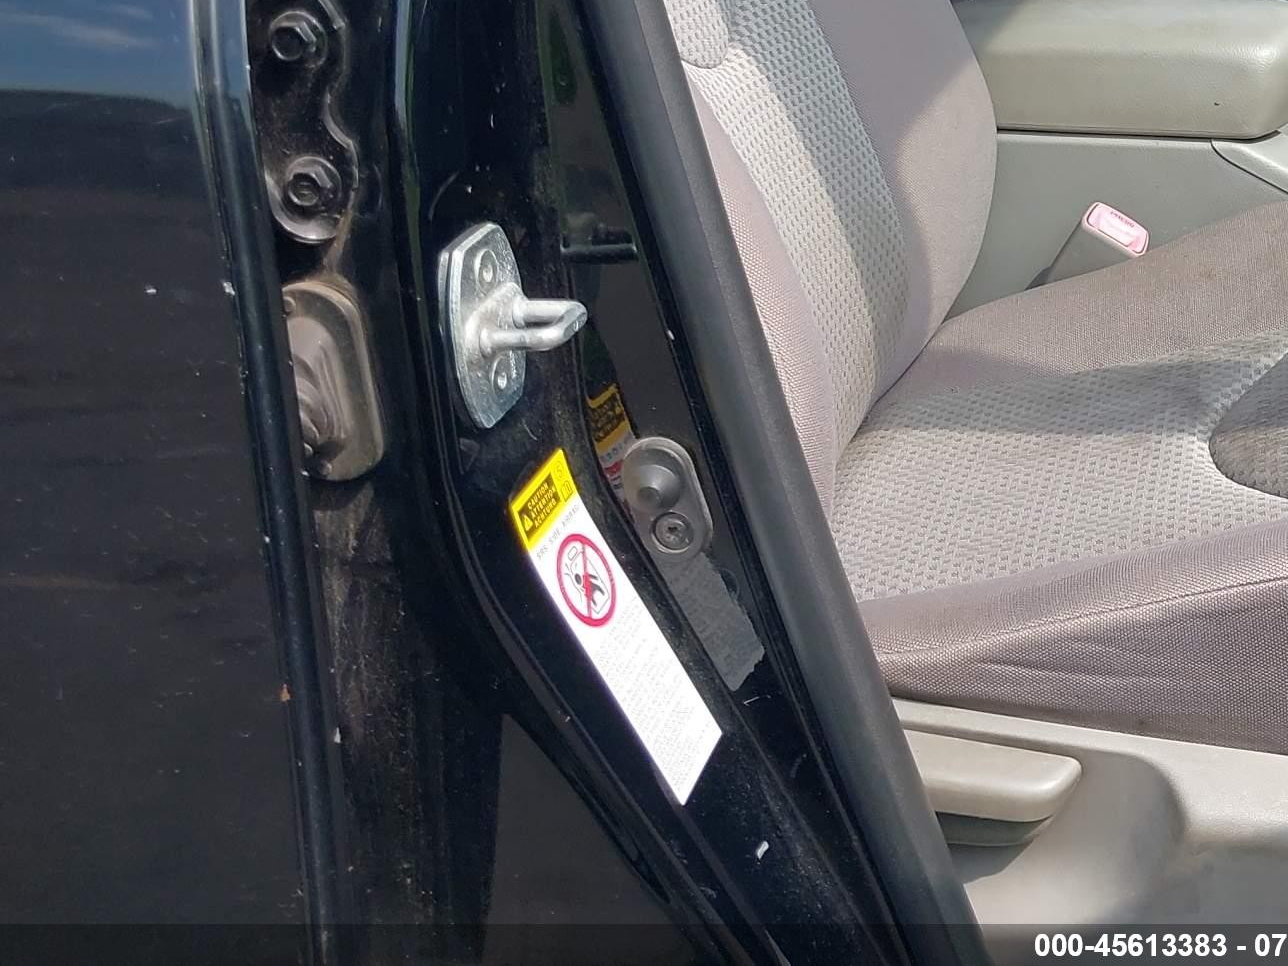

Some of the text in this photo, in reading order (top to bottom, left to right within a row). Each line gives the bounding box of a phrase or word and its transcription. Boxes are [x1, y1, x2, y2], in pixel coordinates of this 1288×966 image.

[527, 482, 549, 510] CAUTION
[530, 485, 556, 519] ATTENTION
[534, 498, 557, 528] ACHTUNG
